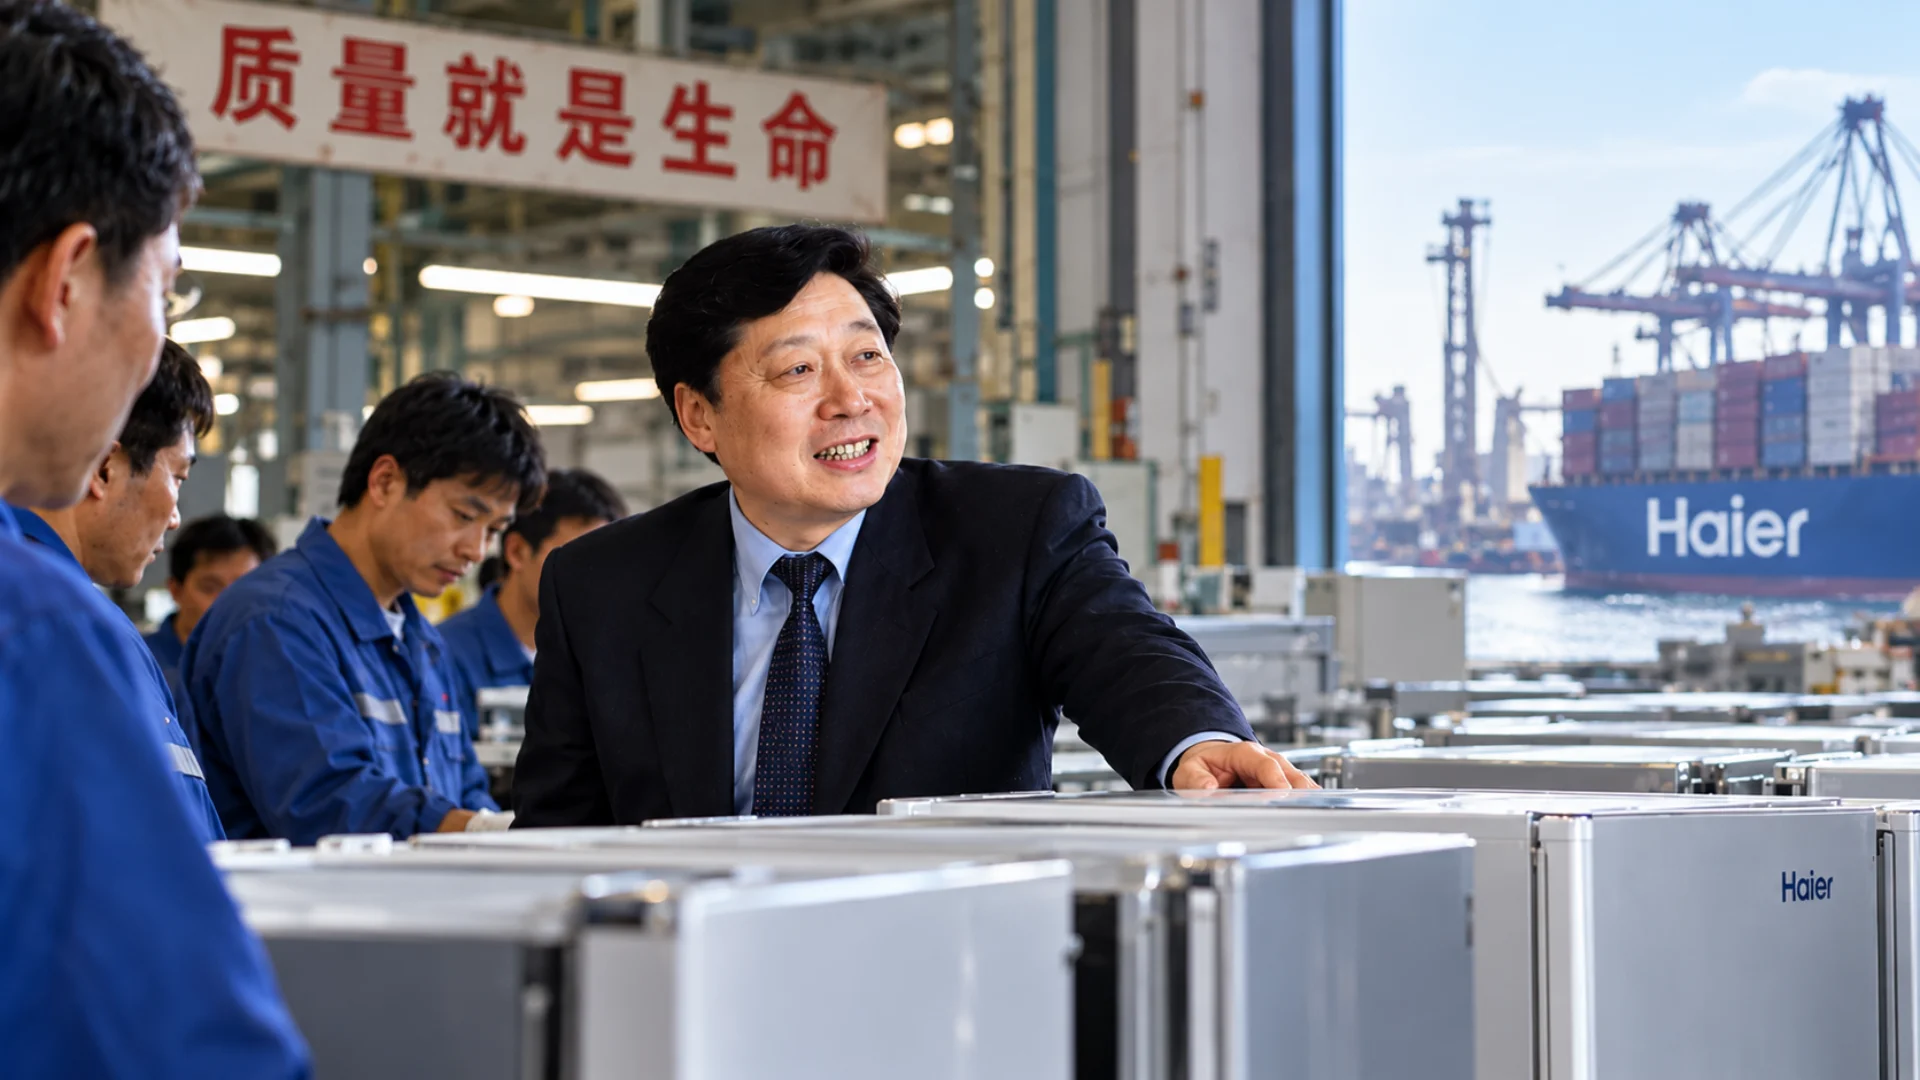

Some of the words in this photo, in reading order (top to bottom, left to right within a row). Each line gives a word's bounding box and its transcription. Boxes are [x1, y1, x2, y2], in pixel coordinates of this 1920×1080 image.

[211, 25, 837, 190] 质量就是生命
[1647, 494, 1809, 557] Haier
[1782, 869, 1834, 903] Haier
